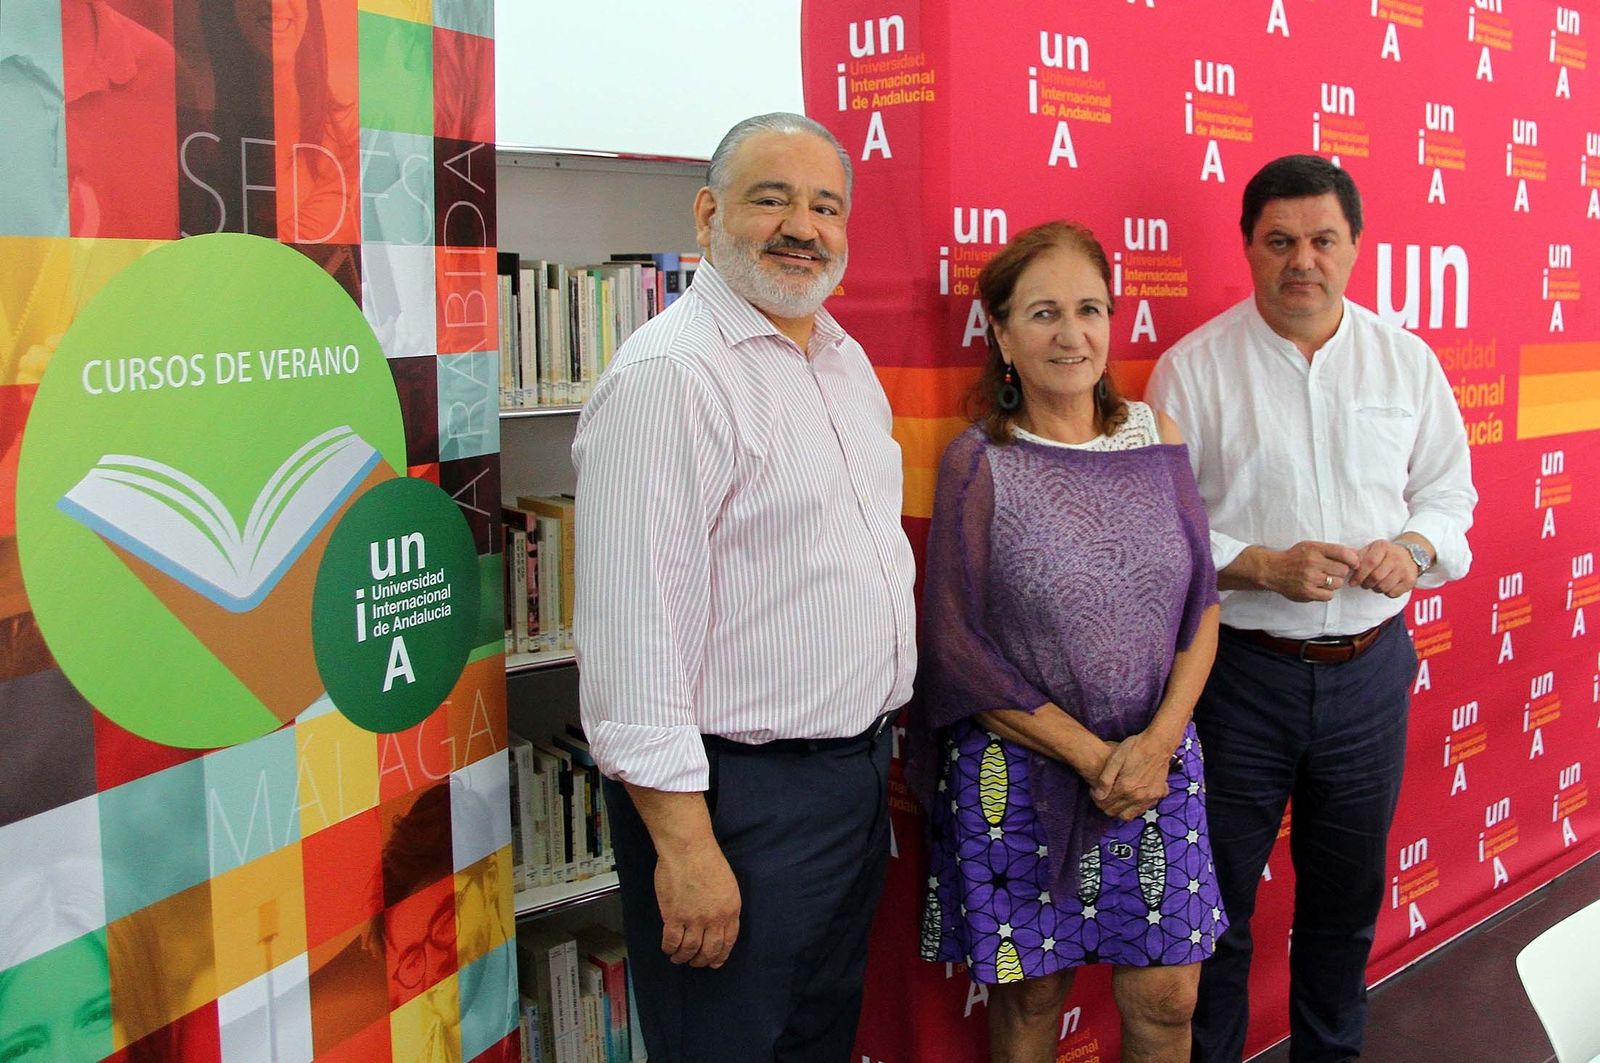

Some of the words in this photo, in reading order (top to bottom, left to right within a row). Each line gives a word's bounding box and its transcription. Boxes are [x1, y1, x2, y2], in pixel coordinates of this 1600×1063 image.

[1266, 0, 1290, 37] A
[1557, 6, 1580, 36] un
[849, 15, 905, 59] un
[1039, 31, 1089, 72] un
[1380, 23, 1401, 62] A
[850, 53, 926, 76] Universidad
[1194, 59, 1236, 97] un
[1476, 46, 1493, 82] A
[837, 63, 848, 112] i
[850, 70, 936, 94] Internacional
[1028, 66, 1038, 114] i
[1041, 86, 1112, 108] Internacional
[1555, 66, 1571, 99] A
[851, 94, 869, 111] de
[871, 88, 936, 108] Andalucía
[1041, 102, 1056, 117] de
[1185, 91, 1194, 135] i
[1320, 82, 1355, 117] un
[1312, 112, 1320, 152] i
[1425, 102, 1455, 133] un
[1512, 118, 1538, 147] un
[861, 111, 893, 161] A
[1048, 120, 1078, 169] A
[1418, 129, 1425, 165] i
[1586, 132, 1600, 157] u
[1200, 139, 1225, 183] A
[180, 131, 433, 247] SEDES
[1427, 168, 1446, 205] A
[1513, 179, 1530, 213] A
[953, 207, 1008, 245] un
[1124, 217, 1168, 251] un
[940, 246, 949, 295] i
[953, 246, 994, 261] Univer
[1124, 252, 1182, 268] Universidad
[1548, 244, 1572, 269] un
[953, 280, 970, 296] de
[1113, 252, 1122, 297] i
[1124, 267, 1188, 283] Internacional
[1124, 283, 1138, 297] de
[1139, 282, 1188, 298] Andalucía
[1376, 242, 1470, 329] un
[962, 299, 989, 348] A
[1131, 299, 1157, 343] A
[1549, 300, 1564, 332] A
[82, 353, 206, 396] CURSOS
[216, 350, 253, 385] DE
[259, 343, 361, 381] VERANO
[1541, 450, 1564, 476] un
[1541, 507, 1556, 539] A
[370, 530, 426, 581] un
[1571, 552, 1593, 579] un
[372, 567, 445, 601] Universidad
[1498, 572, 1523, 600] un
[356, 588, 367, 643] i
[372, 583, 452, 620] Internacional
[1414, 595, 1442, 626] un
[373, 621, 390, 638] de
[392, 602, 452, 633] Andalucía
[1572, 607, 1586, 638] A
[382, 635, 417, 693] A
[1498, 631, 1514, 664] A
[1413, 659, 1431, 694] A
[1530, 671, 1554, 699] un
[1452, 700, 1479, 732] un
[1529, 728, 1545, 760] A
[206, 688, 499, 880] MÁLAGA
[1451, 762, 1468, 796] A
[1559, 762, 1581, 790] un
[1485, 796, 1510, 828] un
[1562, 817, 1578, 848] A
[1399, 837, 1428, 872] un
[1493, 856, 1509, 889] A
[1408, 902, 1427, 938] A
